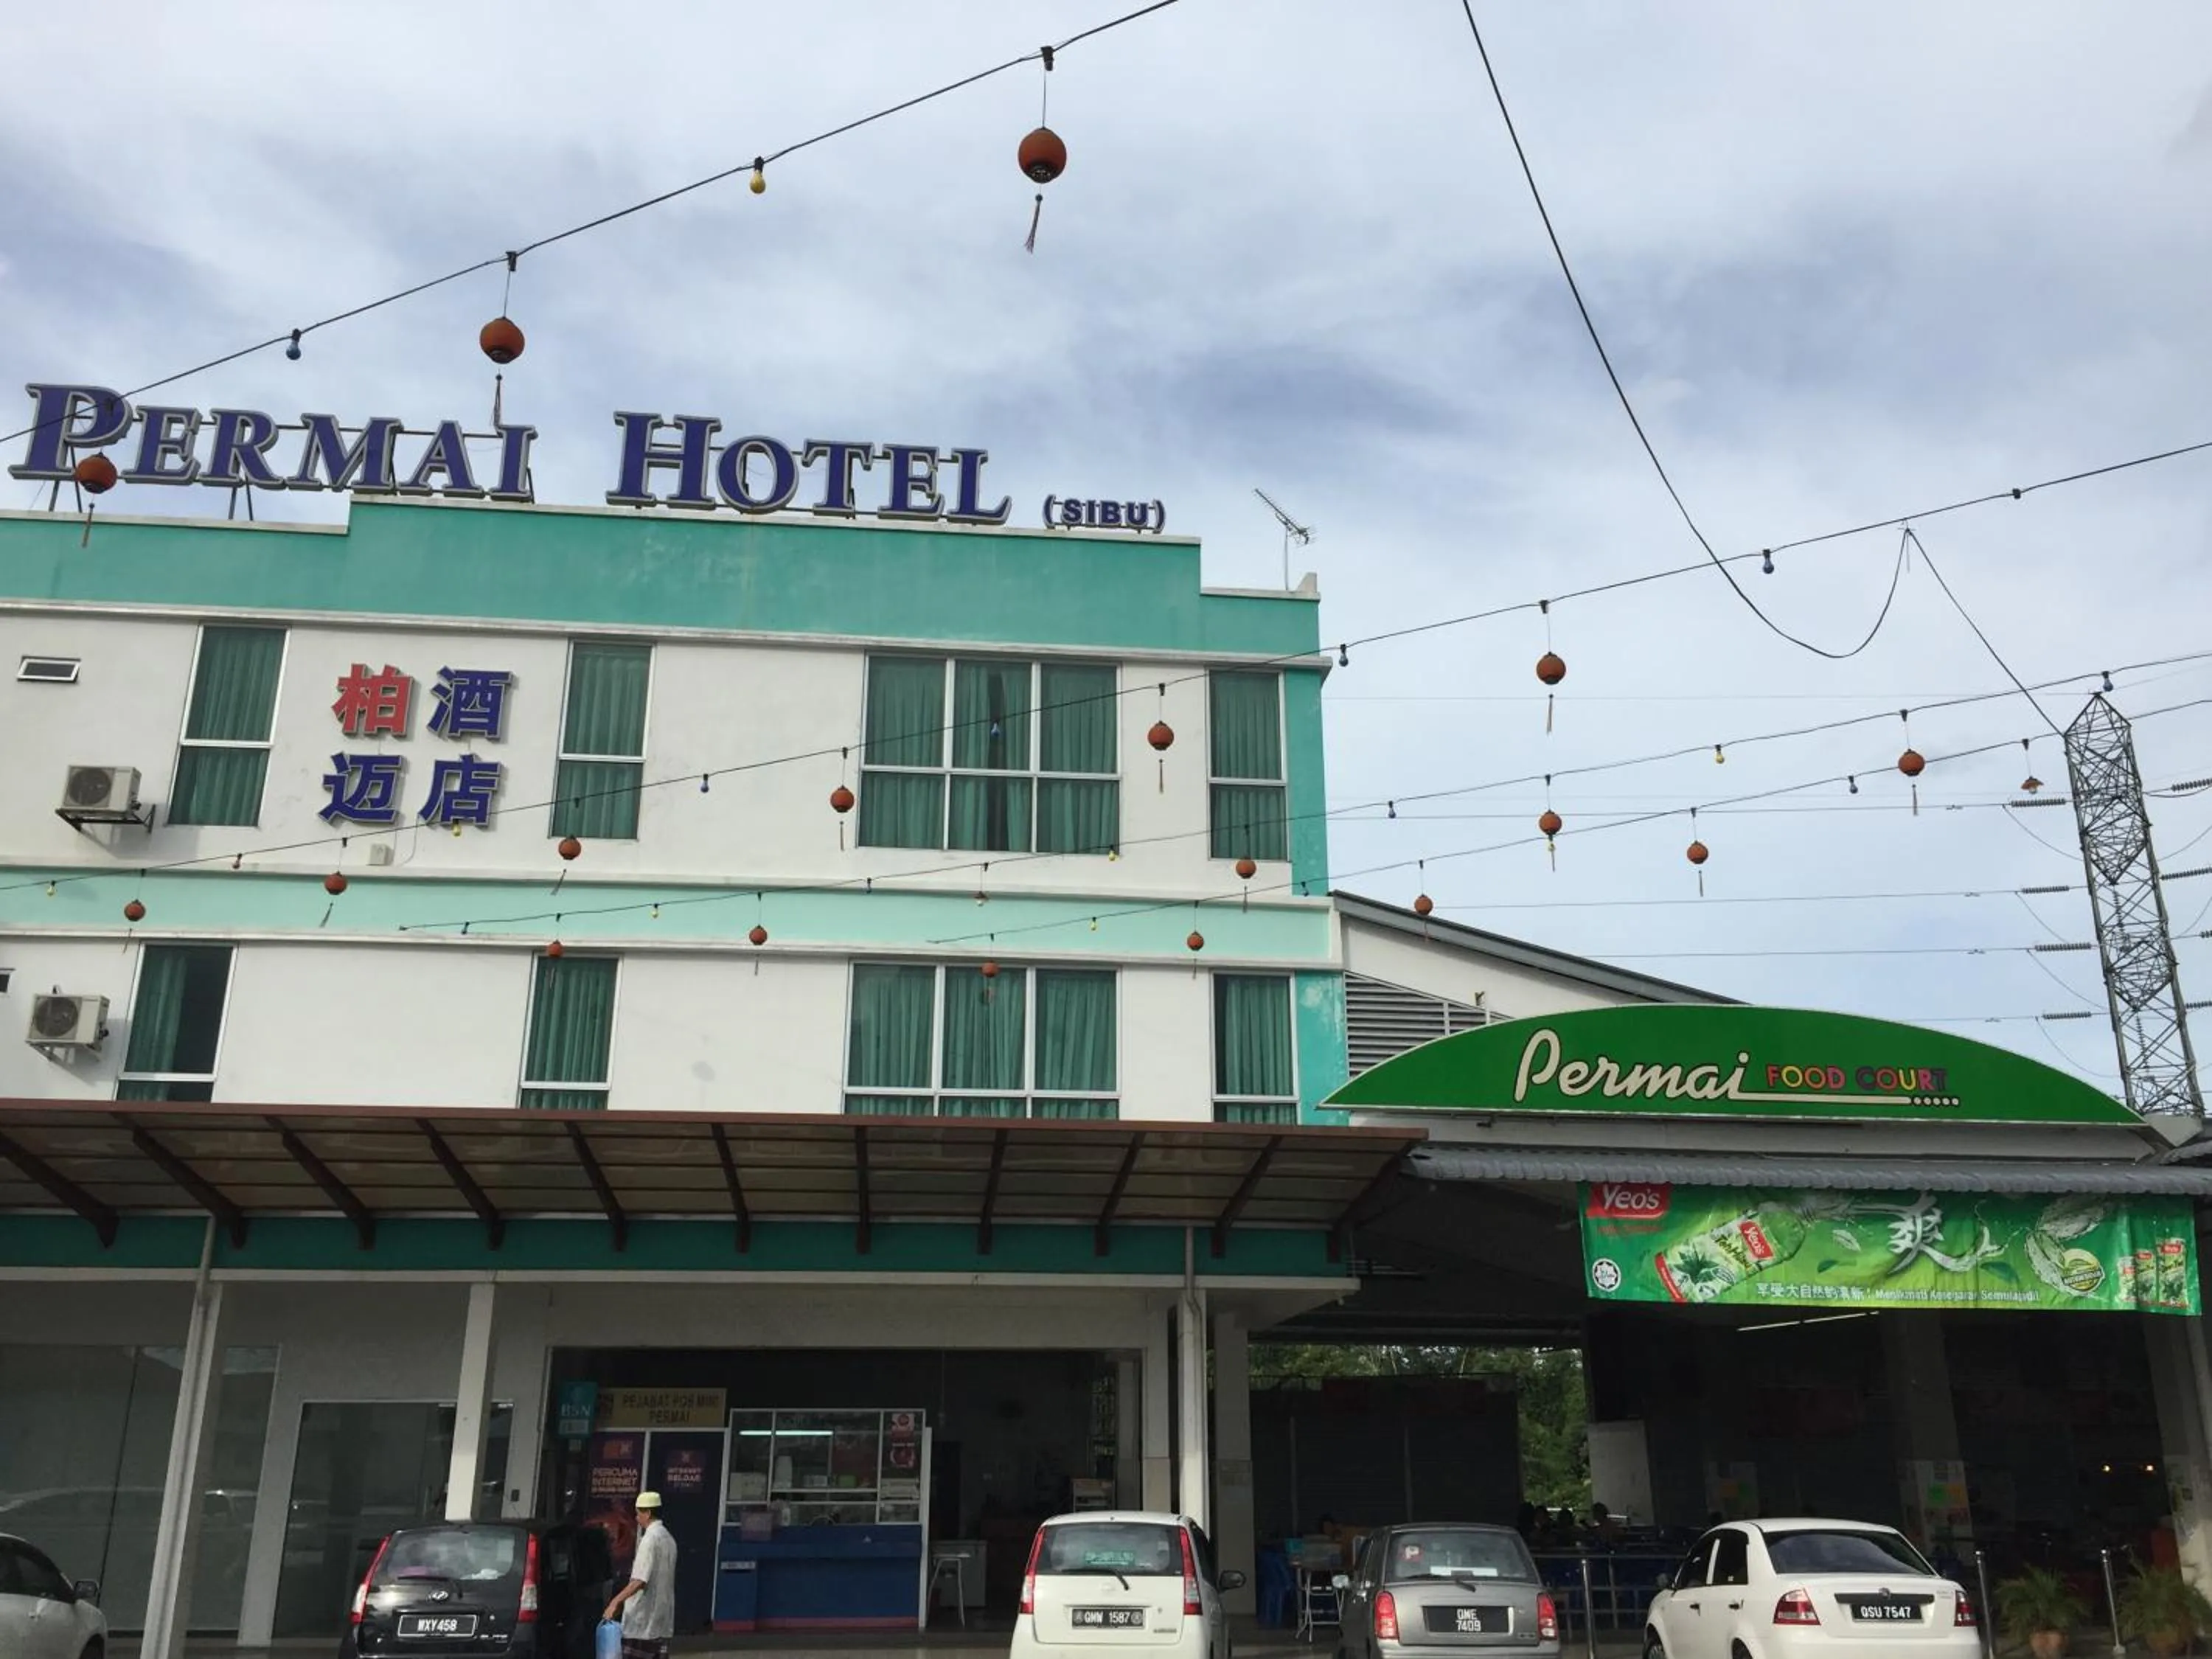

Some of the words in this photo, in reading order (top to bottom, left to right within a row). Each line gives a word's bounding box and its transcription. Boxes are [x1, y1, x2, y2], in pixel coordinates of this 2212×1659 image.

[8, 382, 538, 501] PERMAI
[606, 411, 1013, 525] HOTEL
[1043, 493, 1166, 535] (SIBU)
[1513, 1029, 1753, 1103] Permai
[1766, 1064, 1845, 1089] FOOD
[1856, 1065, 1947, 1092] COURT
[1601, 1183, 1660, 1210] Yeo's
[560, 1404, 591, 1417] BSN
[1108, 1610, 1130, 1624] 1587
[1883, 1606, 1911, 1619] 7547
[1455, 1620, 1481, 1632] 7409
